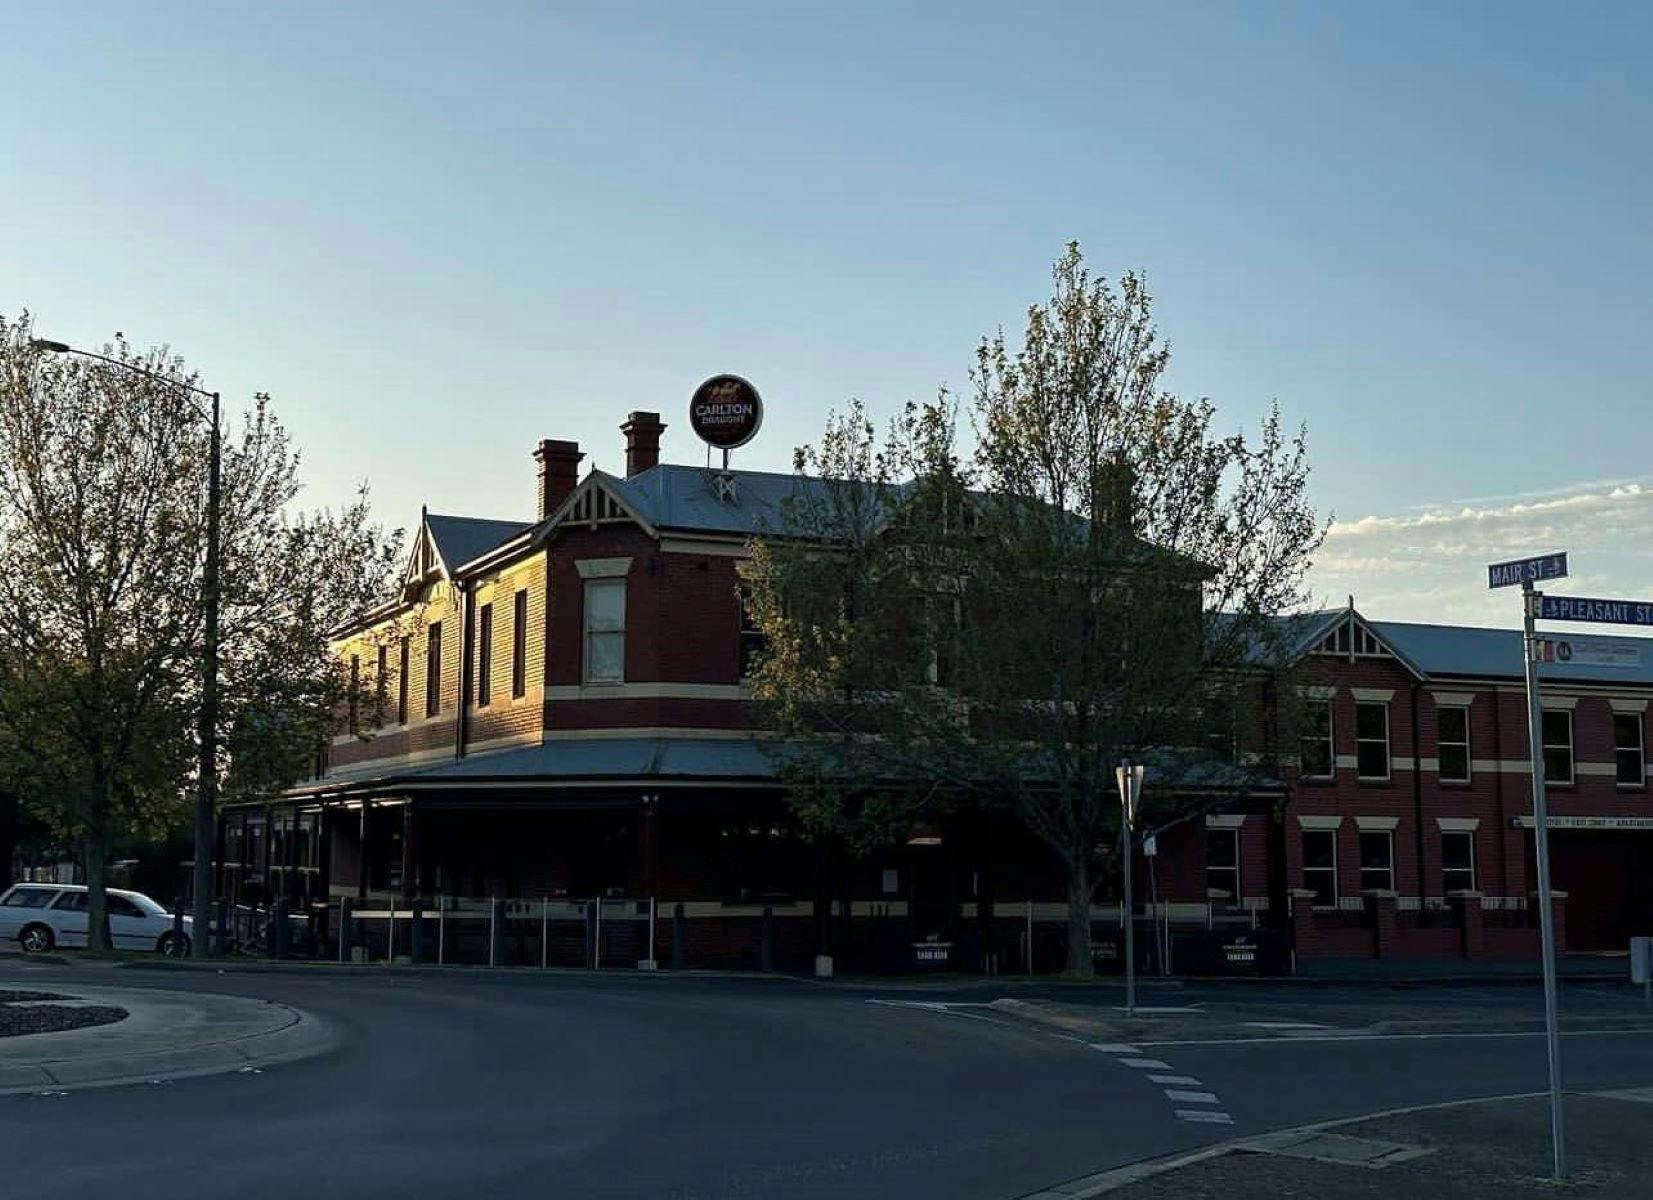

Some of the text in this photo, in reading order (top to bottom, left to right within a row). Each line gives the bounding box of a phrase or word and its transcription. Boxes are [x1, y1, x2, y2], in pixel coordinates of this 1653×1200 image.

[695, 403, 753, 417] CARLTON
[1492, 560, 1544, 586] MAIR ST
[1559, 600, 1651, 624] PLEASANT ST
